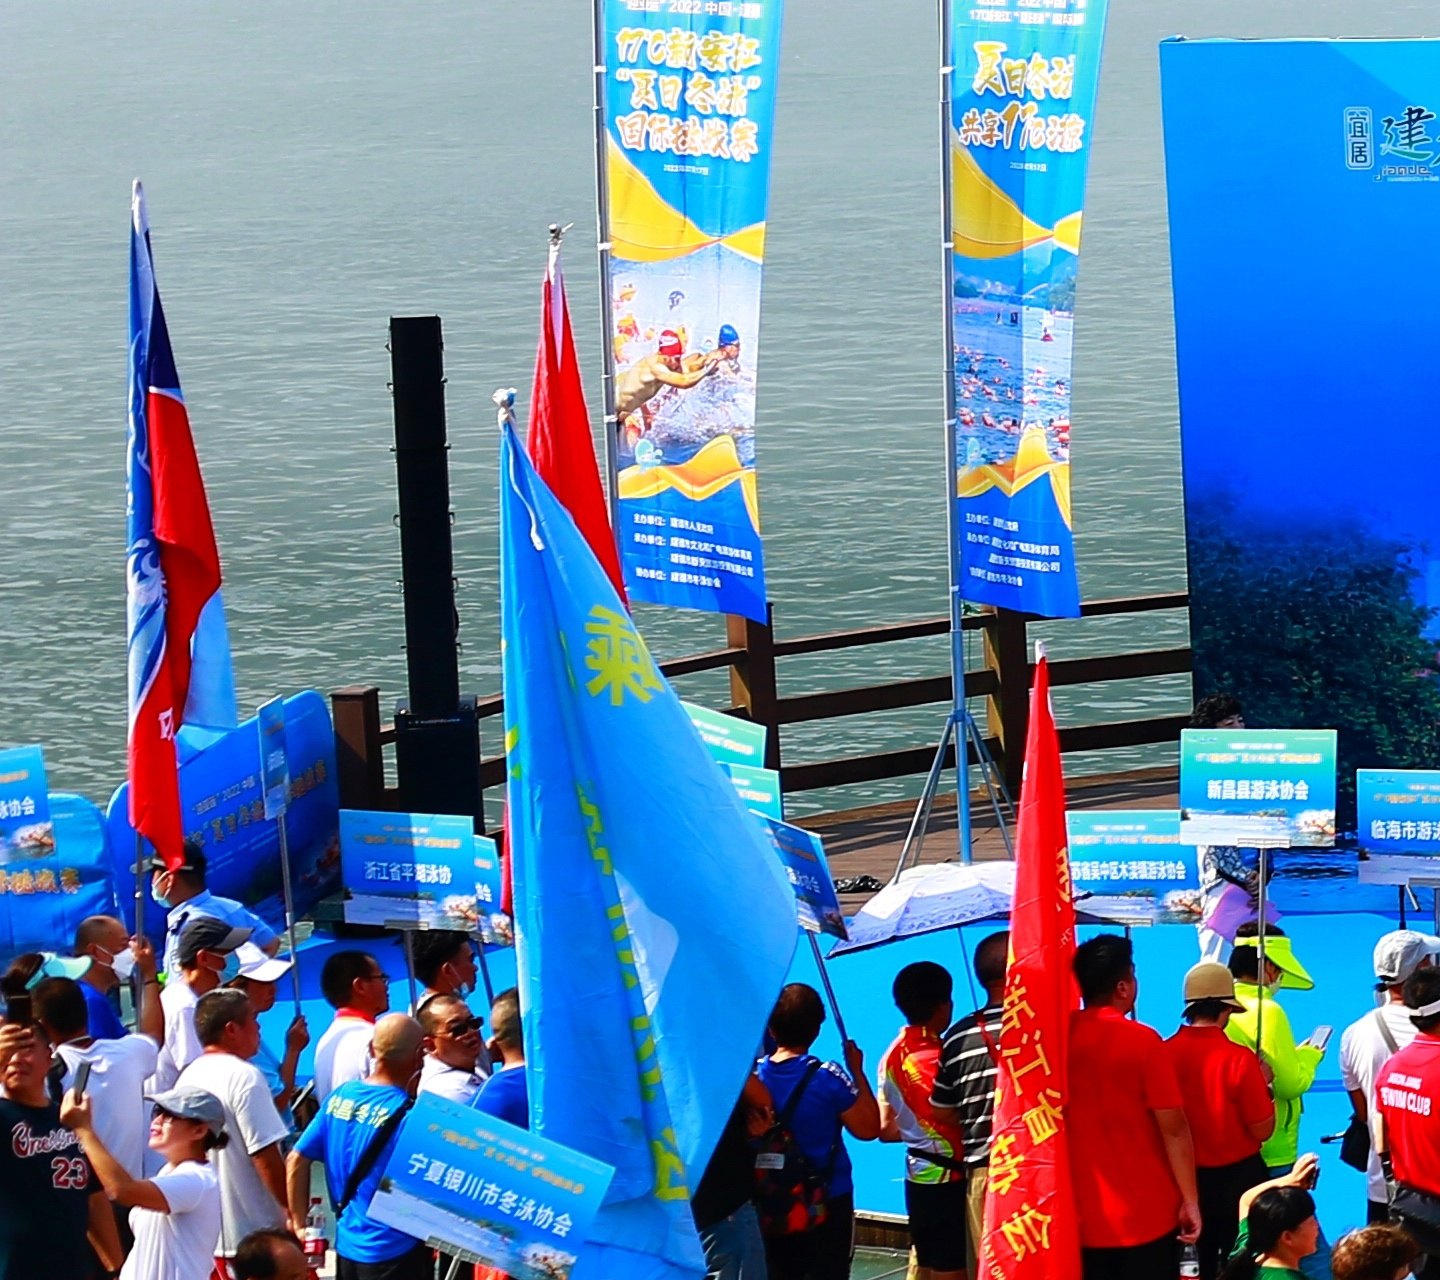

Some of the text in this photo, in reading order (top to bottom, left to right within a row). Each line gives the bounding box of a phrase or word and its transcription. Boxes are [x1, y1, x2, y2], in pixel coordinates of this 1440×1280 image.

[668, 0, 702, 14] 2022
[1206, 779, 1310, 801] 新昌县游泳协会
[363, 860, 453, 886] 浙江省平湖泳协
[1408, 1092, 1432, 1117] CLUB
[51, 1156, 89, 1190] 23
[407, 1150, 575, 1237] 宁夏银川市冬泳协会
